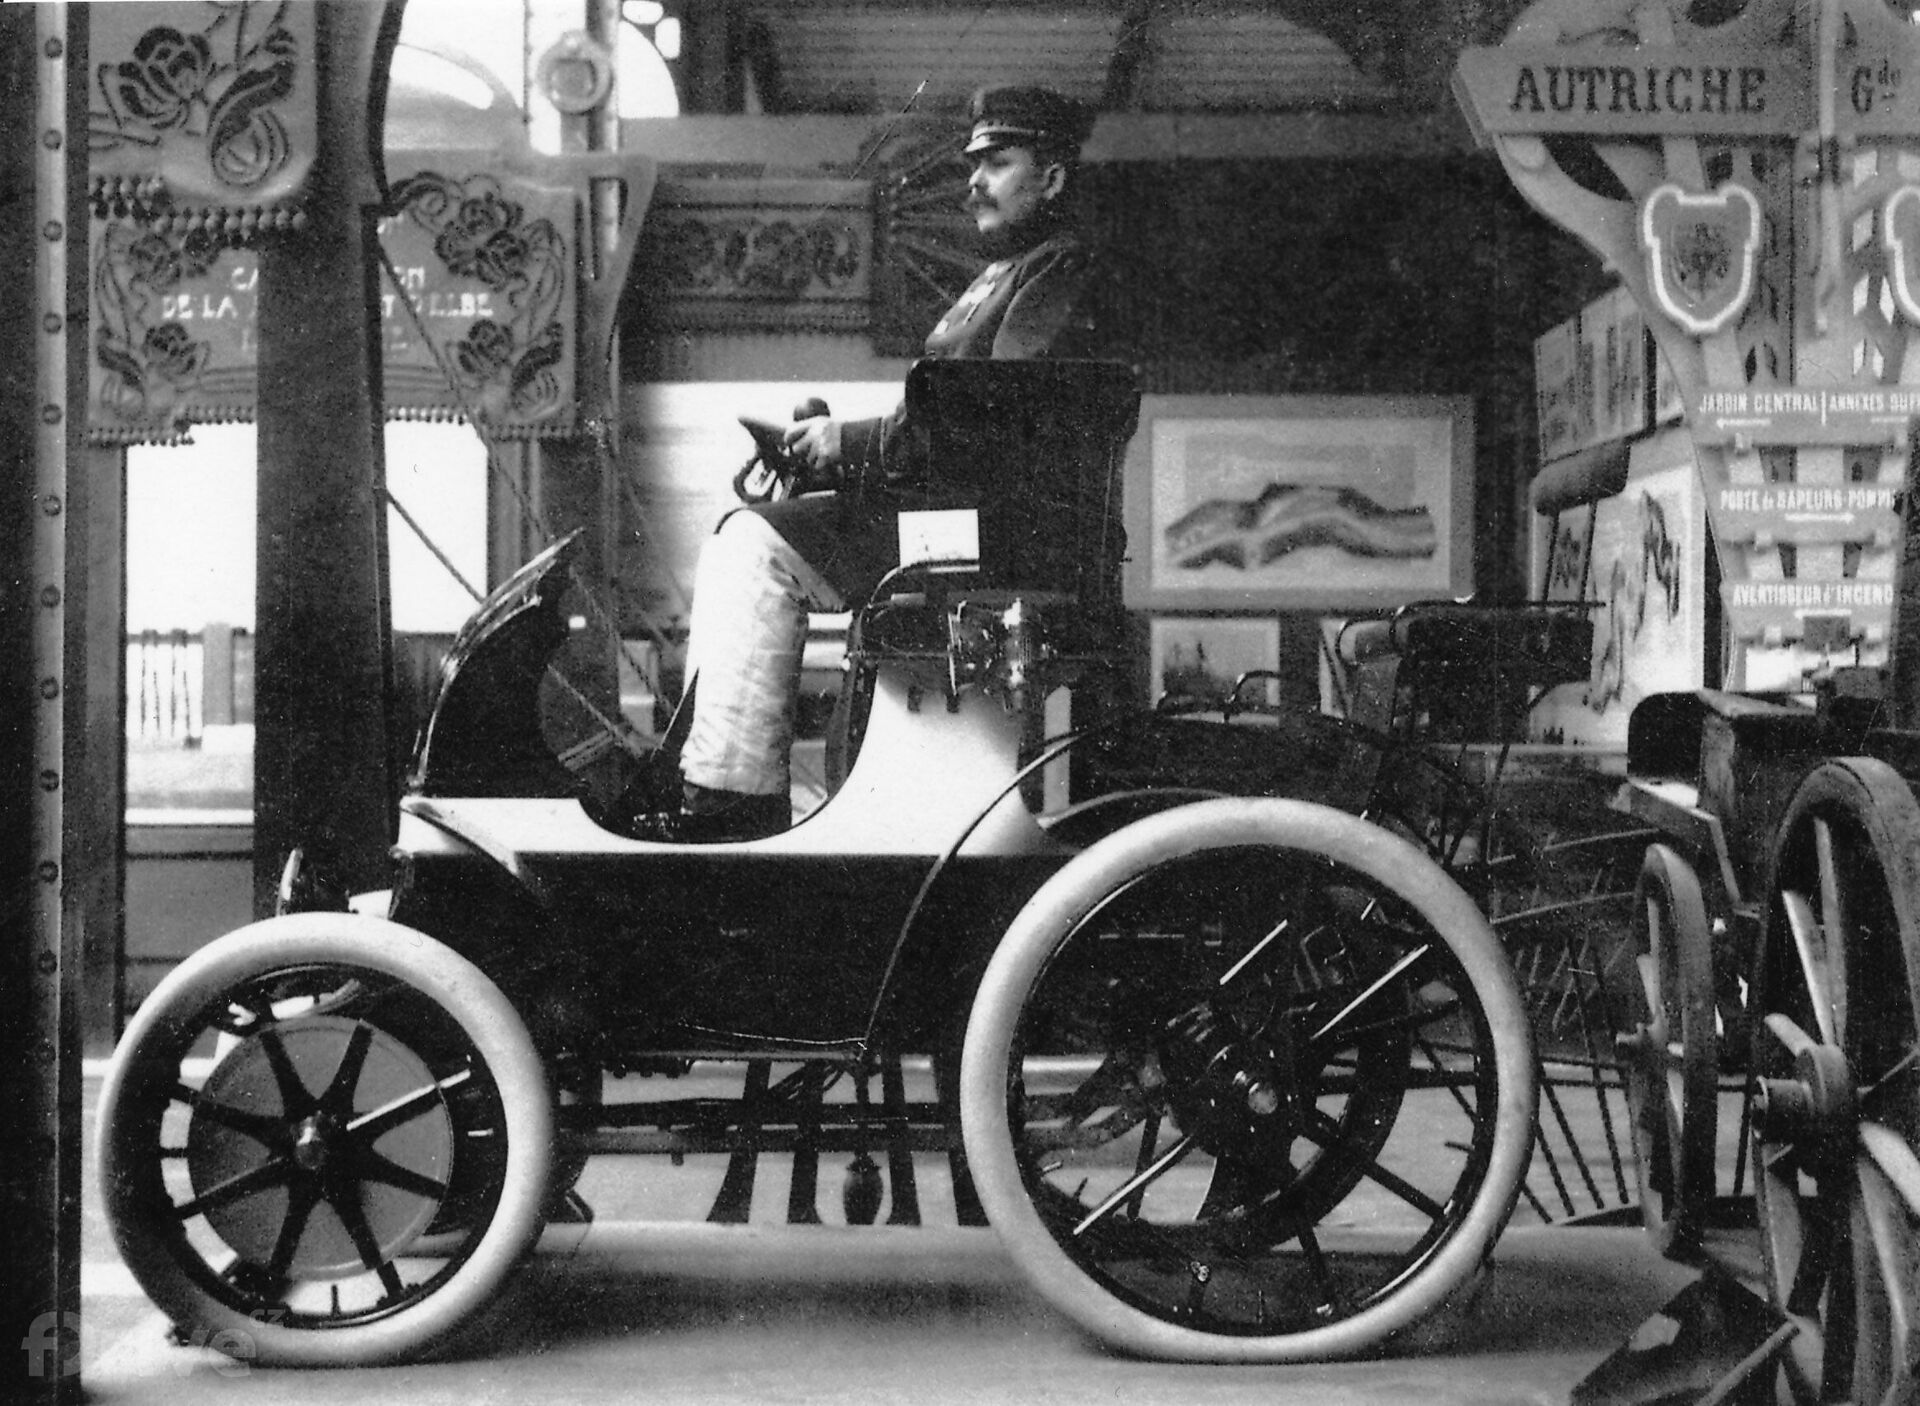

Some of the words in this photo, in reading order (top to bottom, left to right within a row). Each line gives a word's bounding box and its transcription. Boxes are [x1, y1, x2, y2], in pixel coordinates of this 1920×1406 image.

[1510, 64, 1766, 114] AUTRICHE
[1699, 392, 1748, 414] JARDIN
[1754, 392, 1819, 414] CENTRAL
[1848, 487, 1896, 510] POMPI
